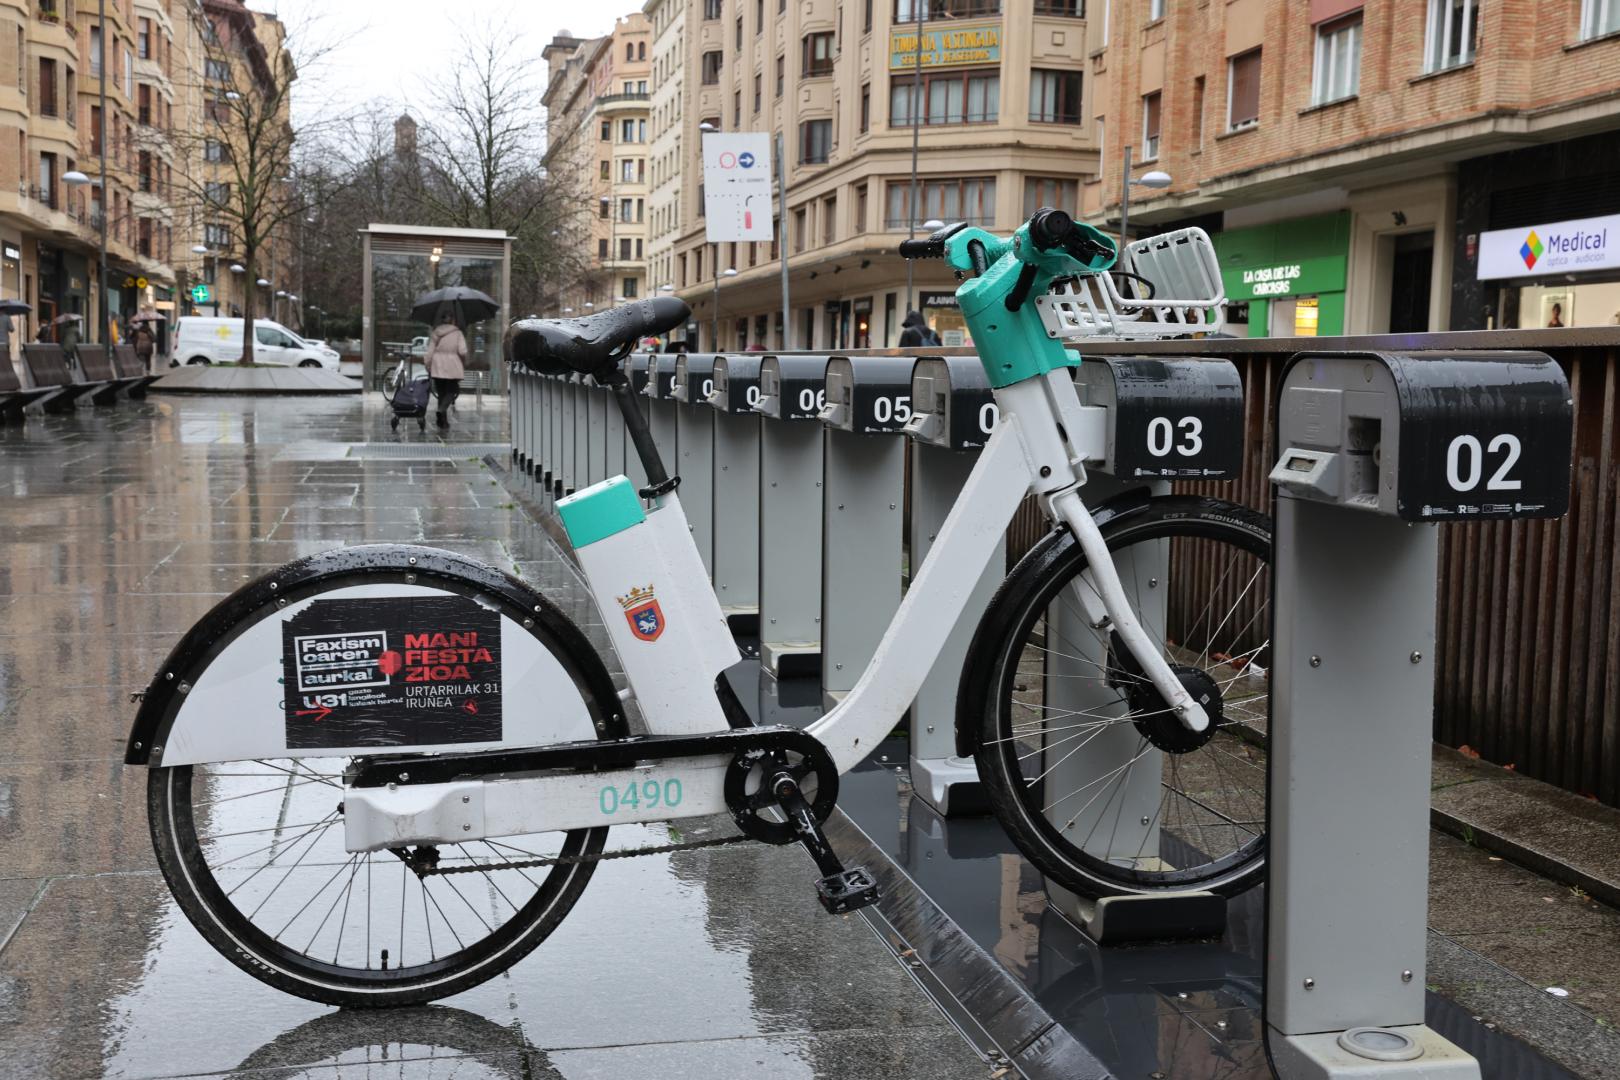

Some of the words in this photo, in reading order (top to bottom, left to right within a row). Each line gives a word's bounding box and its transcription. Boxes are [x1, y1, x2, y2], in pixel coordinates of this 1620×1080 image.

[1548, 227, 1607, 254] Medical
[1243, 270, 1254, 284] LA
[1254, 267, 1273, 282] CASA
[1273, 266, 1285, 281] DE
[1284, 264, 1301, 279] LAS
[1252, 280, 1290, 296] CARCASAS
[874, 396, 911, 423] 05
[978, 402, 1000, 434] 0
[1146, 416, 1203, 457] 03
[1446, 433, 1522, 492] 02
[302, 638, 380, 652] Faxism
[405, 632, 478, 648] MANI
[303, 649, 369, 663] oaren
[405, 648, 493, 665] FESTA
[304, 668, 373, 684] aurka!
[405, 665, 472, 682] ZIOA
[405, 684, 481, 697] URTARRILAK
[484, 682, 499, 694] 31
[406, 696, 453, 709] IRUÑEA
[600, 778, 682, 815] 0490
